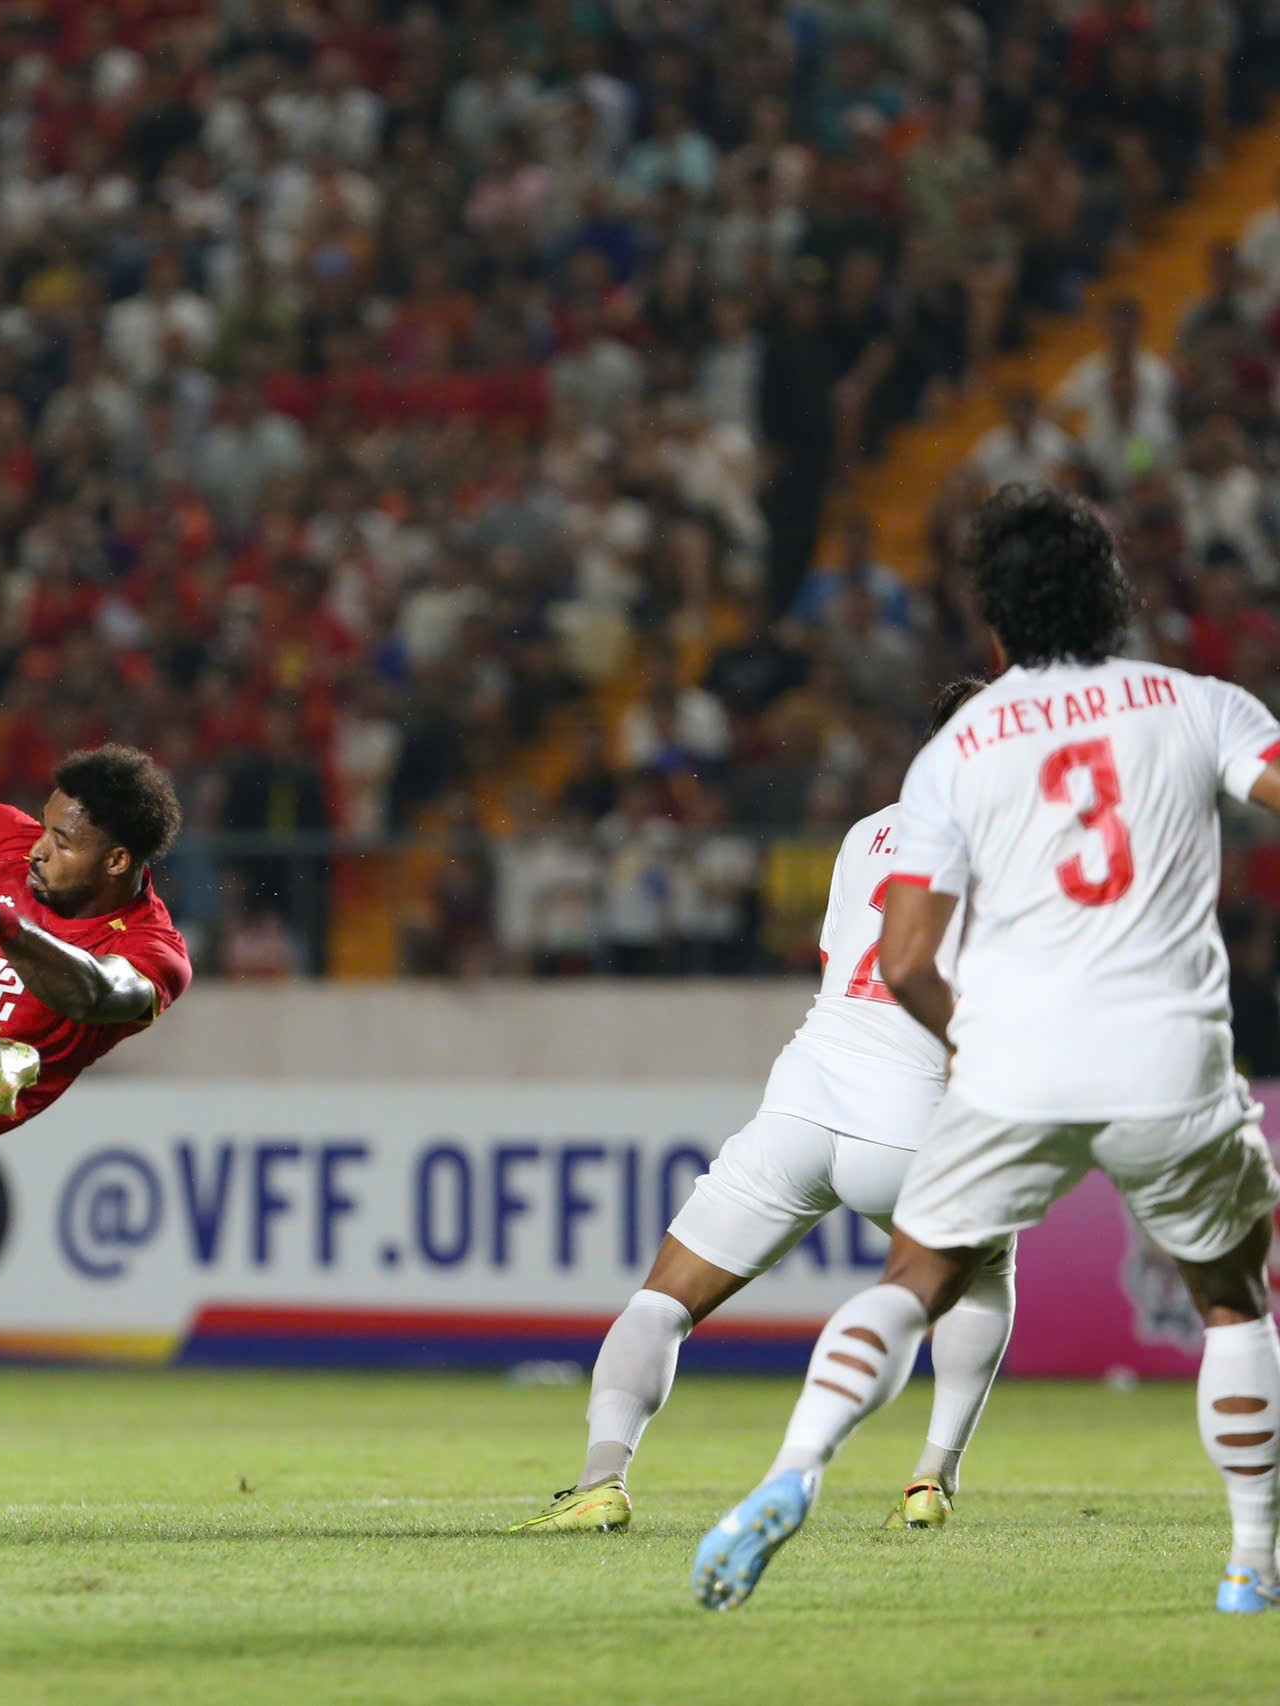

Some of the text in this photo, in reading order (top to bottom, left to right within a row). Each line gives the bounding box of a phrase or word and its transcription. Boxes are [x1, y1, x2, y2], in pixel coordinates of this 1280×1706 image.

[869, 826, 898, 855] H.
[1039, 737, 1135, 907] 3
[54, 1136, 889, 1283] @VFF.OFFIL
